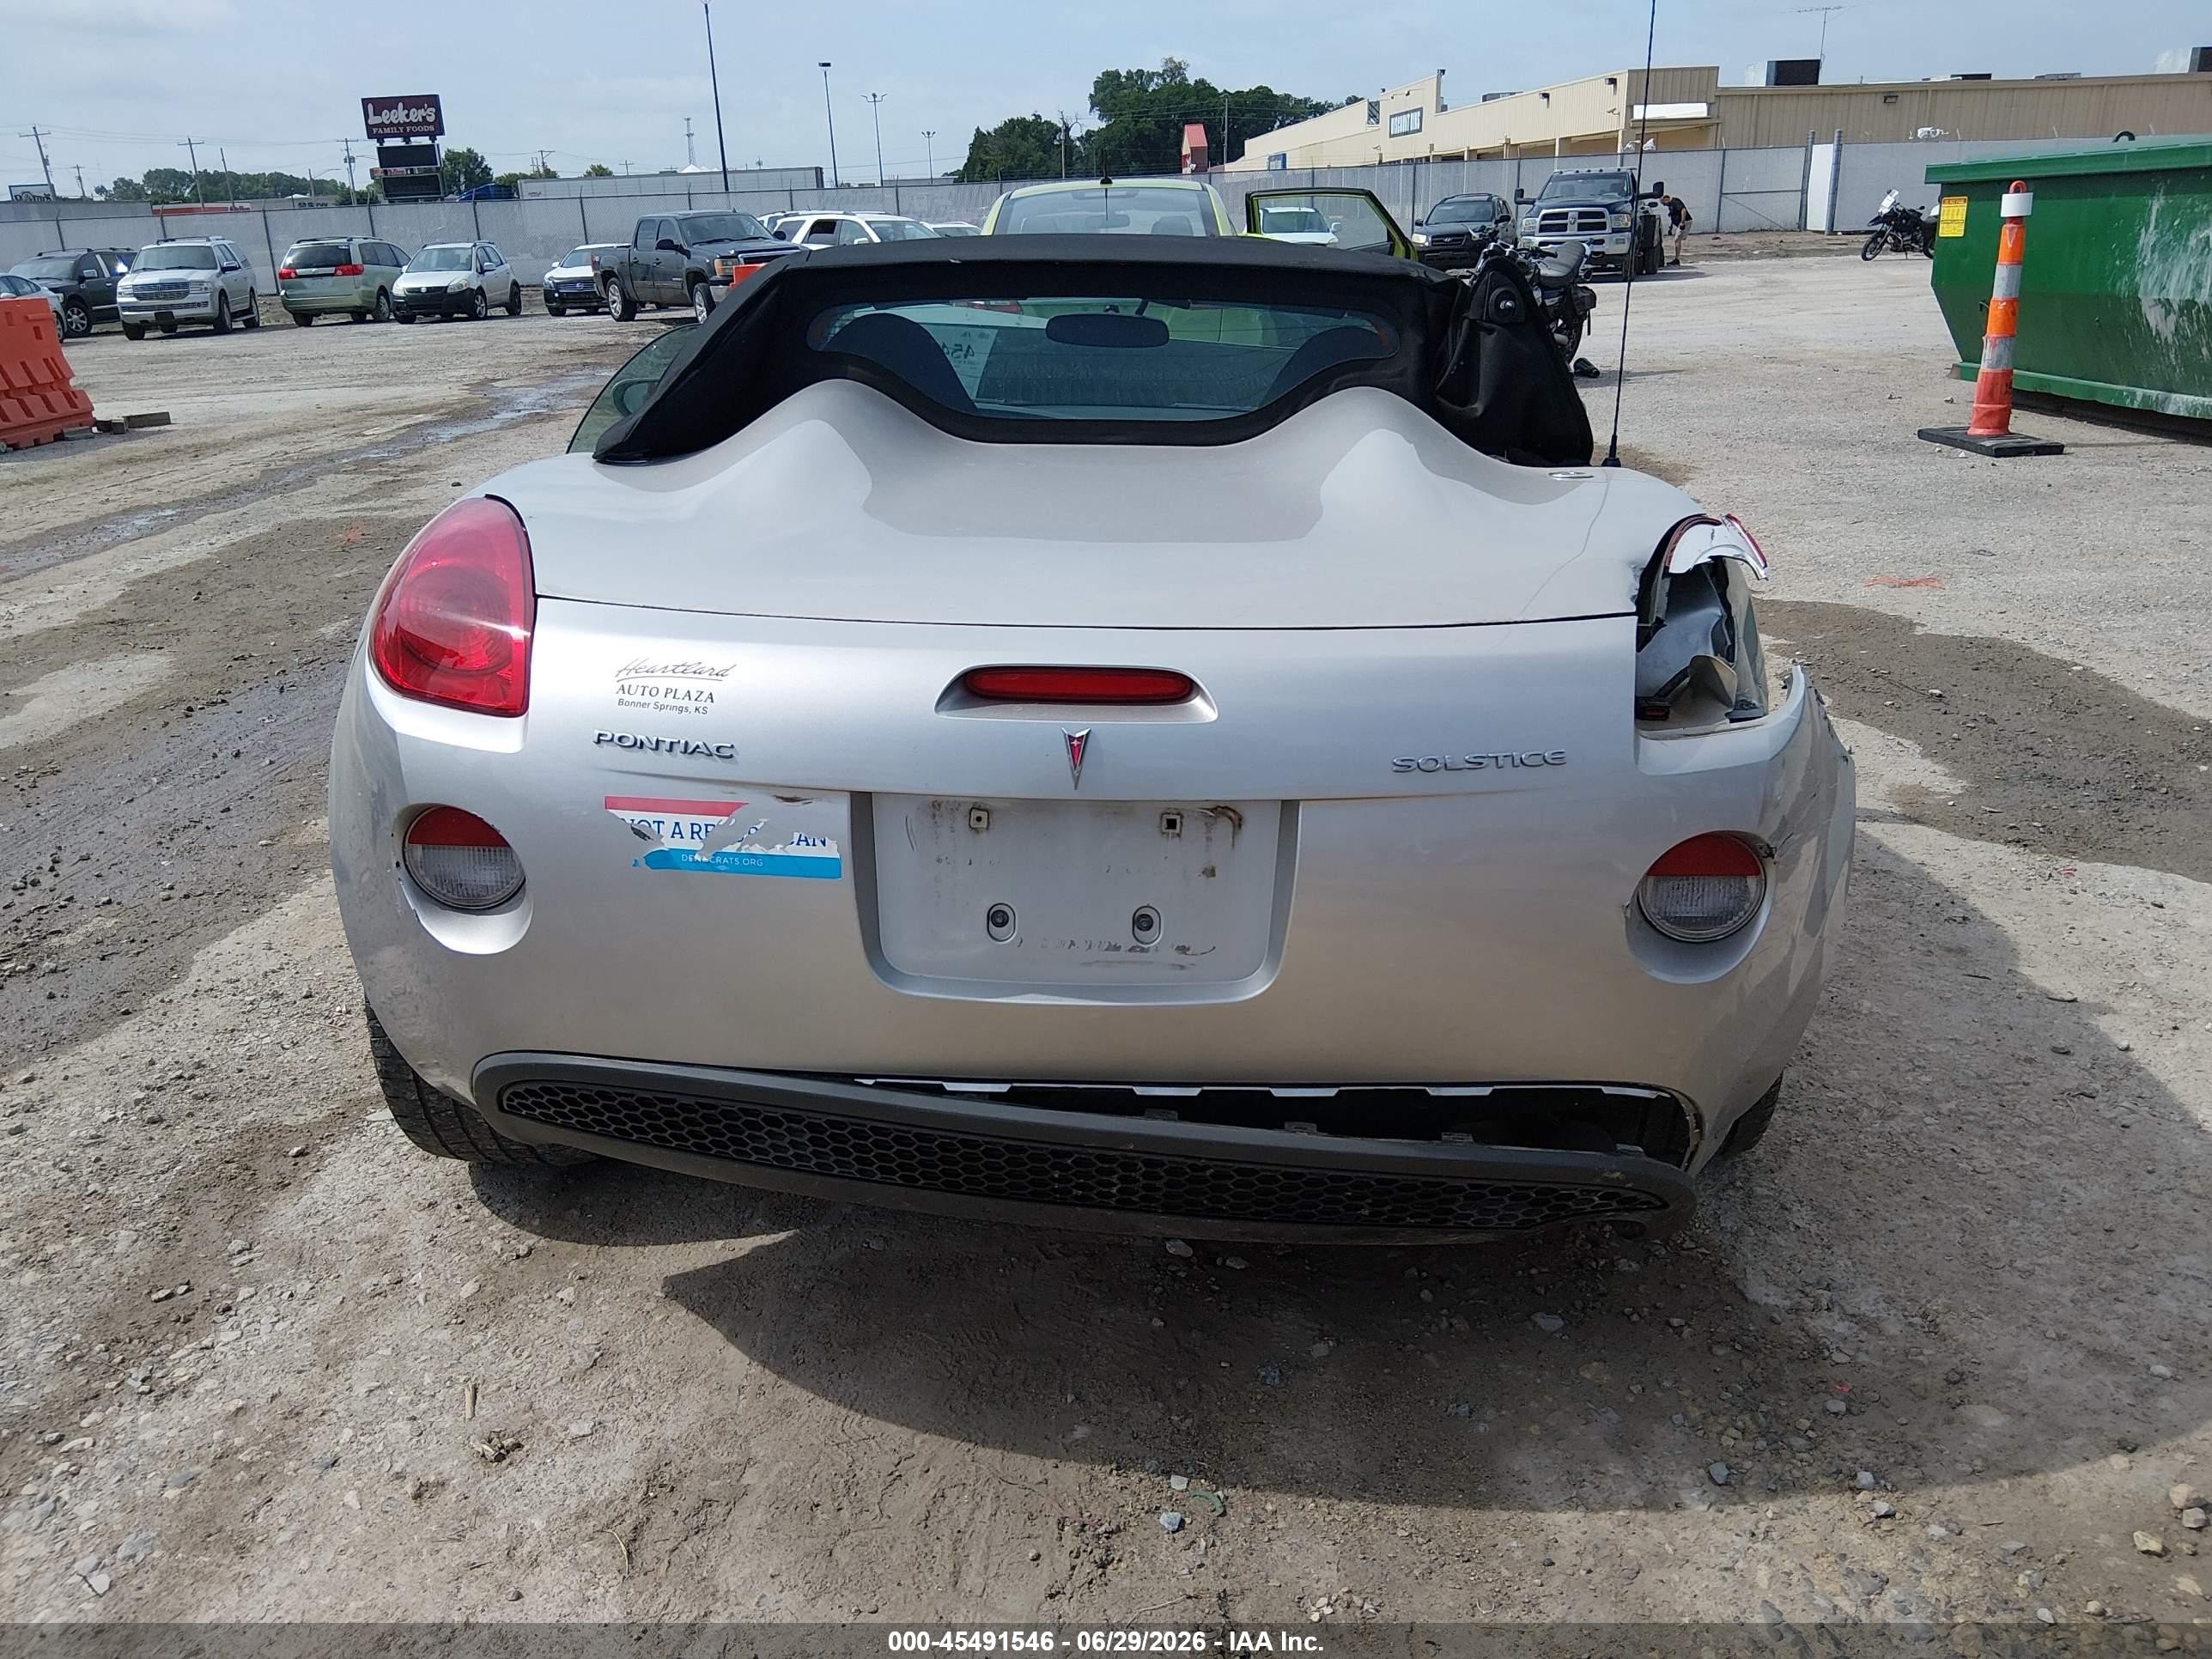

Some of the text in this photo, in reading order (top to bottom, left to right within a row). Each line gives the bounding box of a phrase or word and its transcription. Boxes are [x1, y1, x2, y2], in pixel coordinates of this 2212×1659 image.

[368, 102, 436, 125] Leeker's
[616, 684, 714, 703] AUTO PLAZA
[617, 698, 708, 714] Bonner Springs, KS
[592, 729, 735, 759] PONTIAC
[1391, 749, 1567, 773] SOLSTICE
